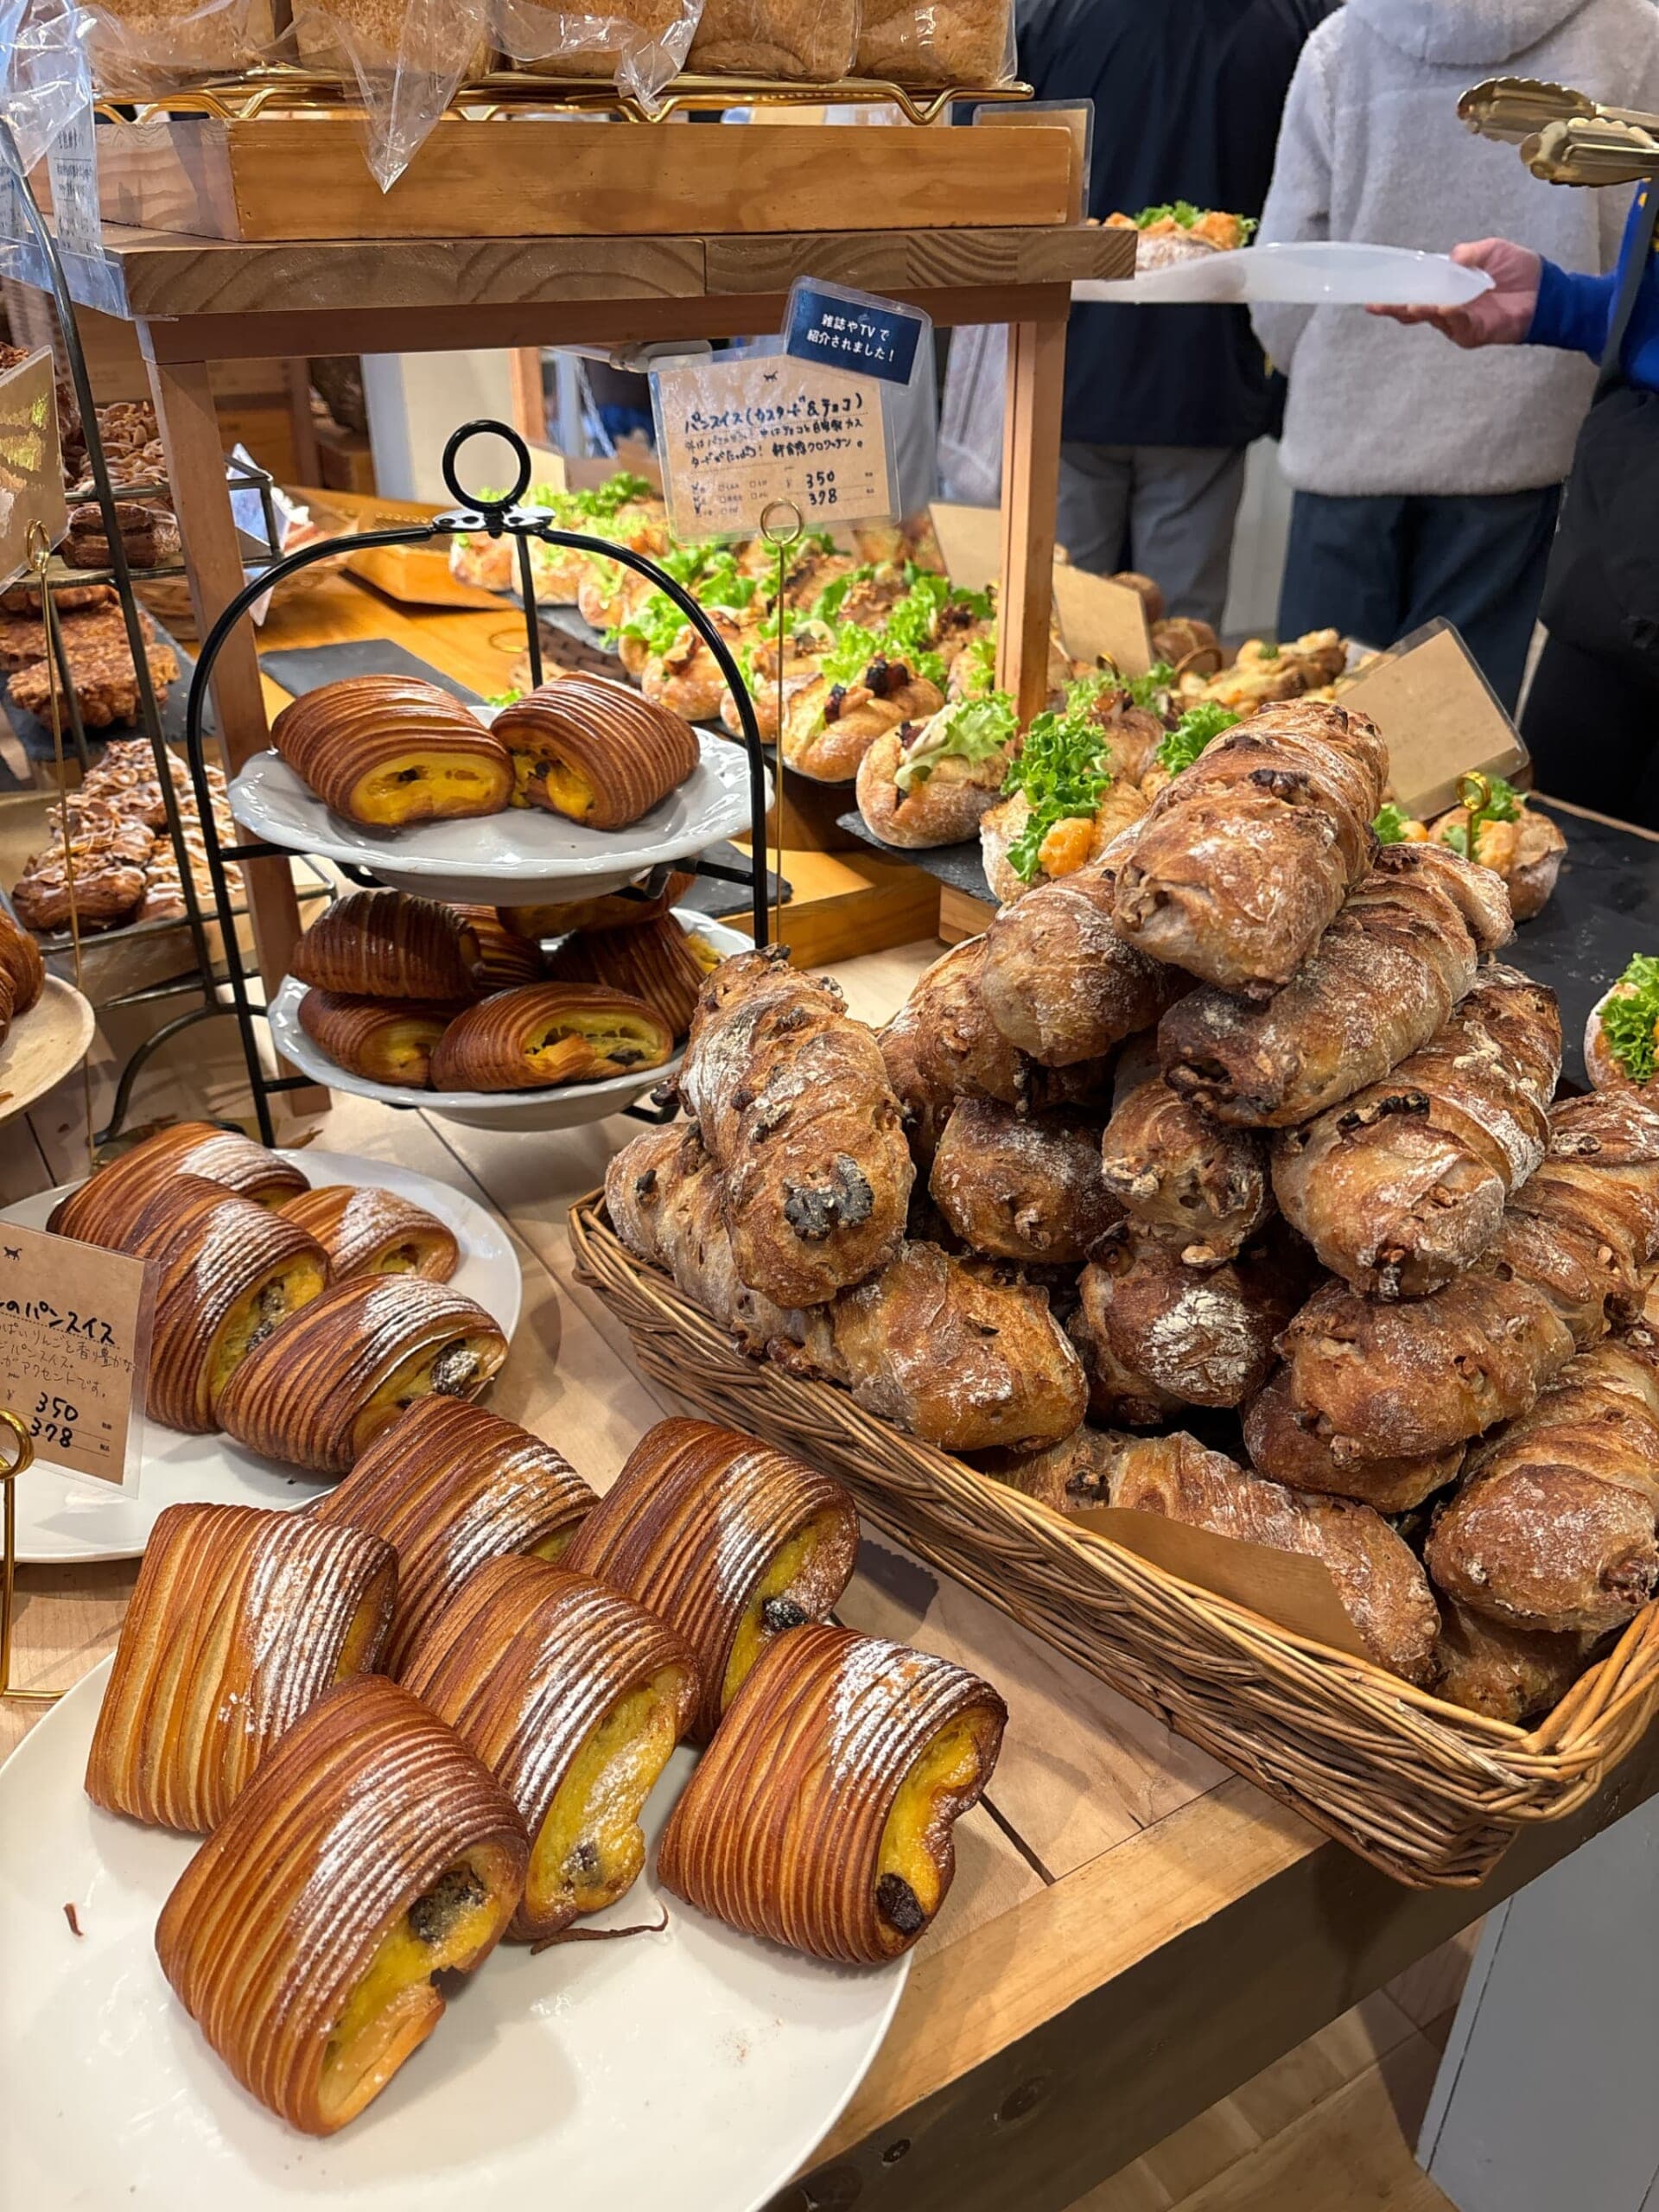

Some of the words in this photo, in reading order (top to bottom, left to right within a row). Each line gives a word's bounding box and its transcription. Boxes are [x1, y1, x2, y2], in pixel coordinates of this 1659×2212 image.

[822, 313, 891, 342] 雑誌やTVで
[806, 328, 895, 362] 紹介されました!
[805, 470, 836, 490] 350
[808, 487, 838, 506] 378
[0, 1300, 115, 1345] のパンスイス
[35, 1391, 79, 1422] 350
[29, 1417, 73, 1448] 378
